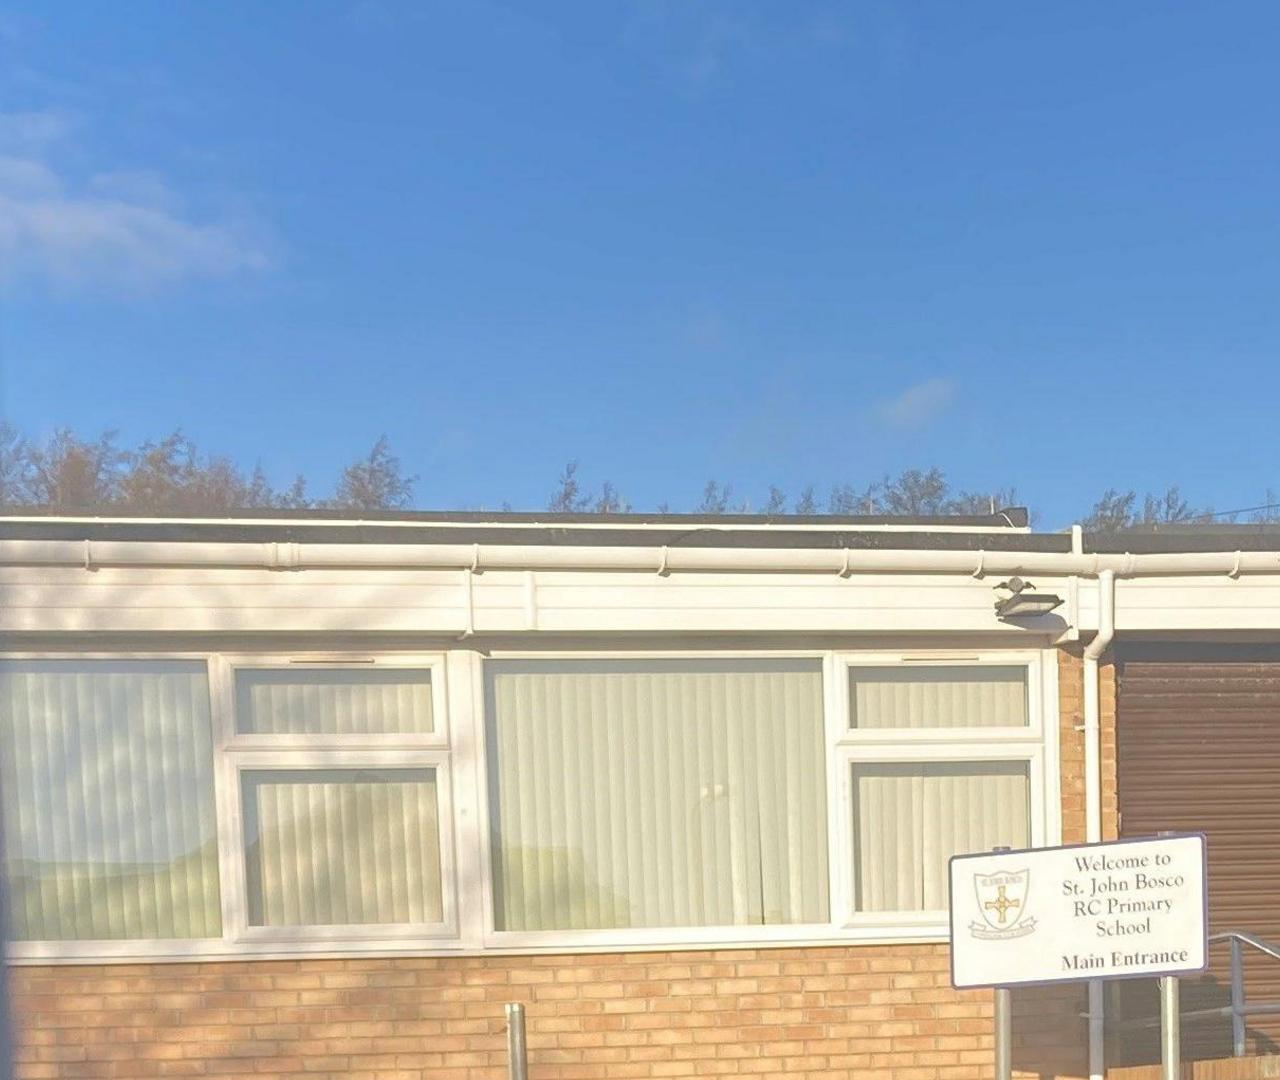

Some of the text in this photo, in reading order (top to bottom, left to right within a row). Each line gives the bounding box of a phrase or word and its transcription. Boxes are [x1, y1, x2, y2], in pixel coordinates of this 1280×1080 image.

[1074, 853, 1172, 873] Welcome to
[1062, 873, 1184, 897] St. John Bosco
[1073, 897, 1173, 917] RC Primary
[1096, 917, 1152, 938] School
[1061, 949, 1189, 972] Main Entrance
